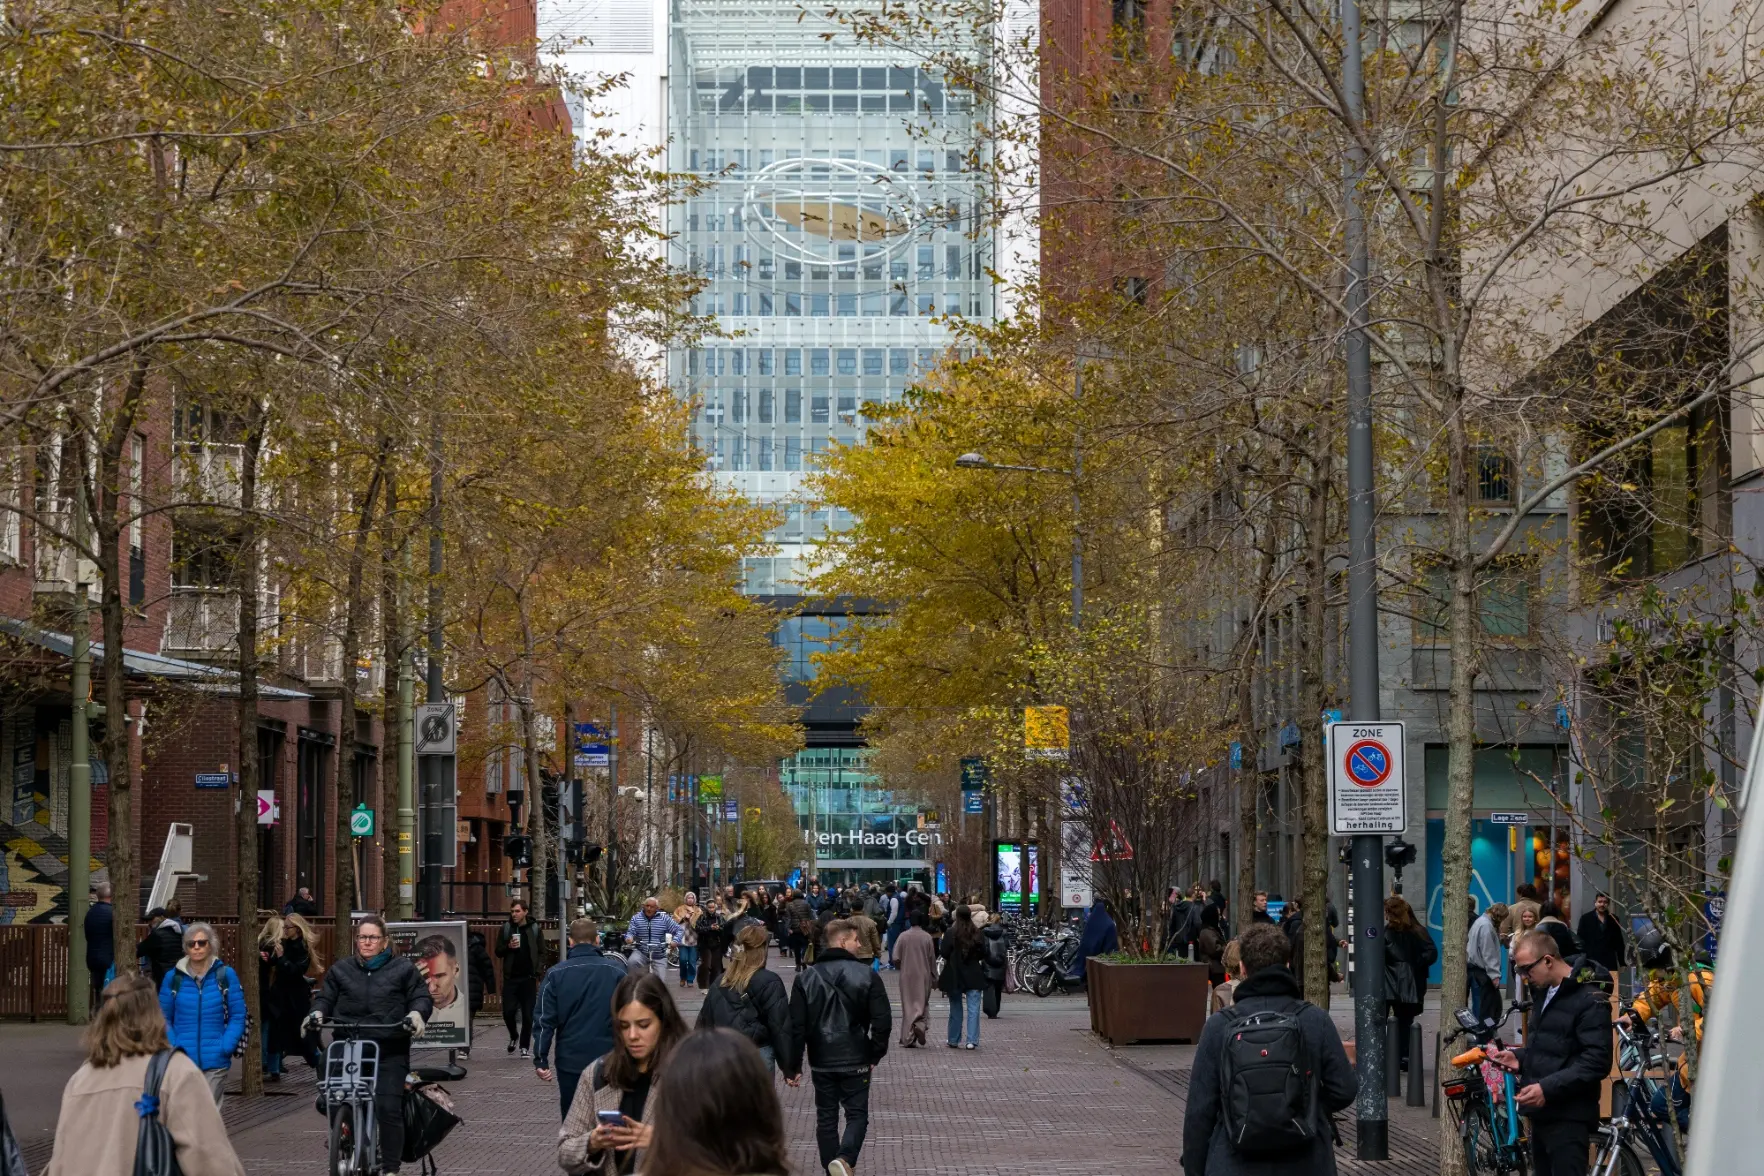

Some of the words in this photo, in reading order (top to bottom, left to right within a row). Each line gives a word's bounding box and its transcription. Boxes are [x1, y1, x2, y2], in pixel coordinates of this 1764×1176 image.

[1352, 729, 1383, 737] ZONE
[1346, 821, 1393, 831] herhaling
[849, 829, 898, 849] Haag
